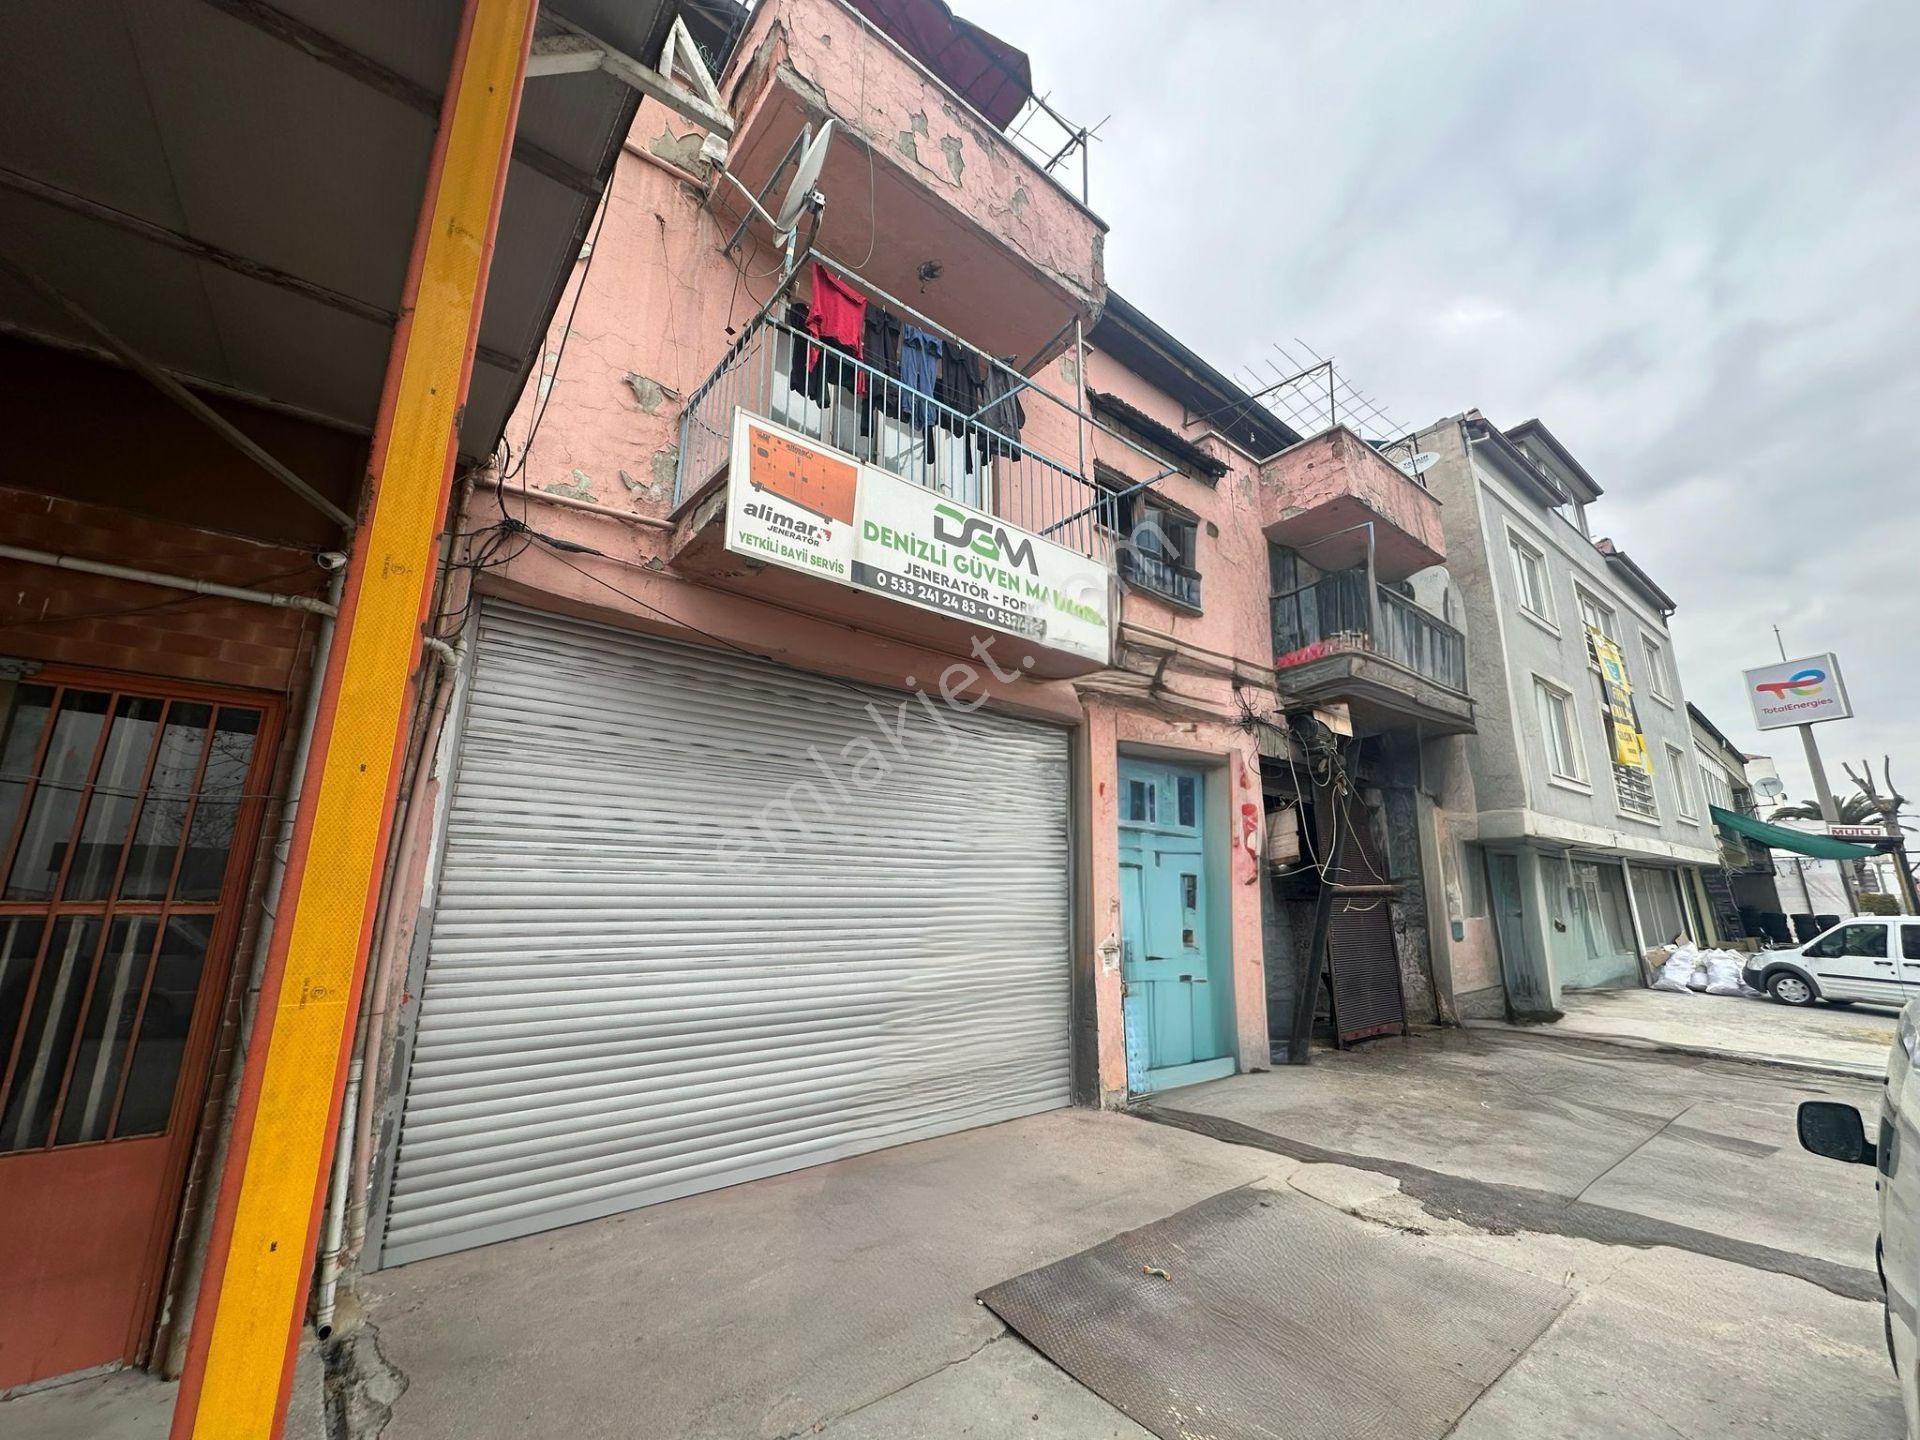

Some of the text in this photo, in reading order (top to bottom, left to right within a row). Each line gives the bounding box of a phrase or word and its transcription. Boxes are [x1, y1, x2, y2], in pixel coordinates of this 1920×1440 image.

[744, 503, 818, 537] alimar
[767, 525, 820, 547] JENERATÖR
[739, 531, 779, 554] YETKİLİ
[810, 558, 844, 574] SERVİS
[863, 519, 1019, 593] DENİZLİ GÜVEN
[876, 572, 886, 587] 0
[890, 577, 914, 596] 533
[918, 585, 939, 604] 241
[942, 594, 958, 609] 24
[961, 600, 976, 615] 83
[986, 608, 995, 620] 0
[903, 562, 989, 601] JENERATÖR
[1761, 697, 1834, 715] TotalEnergies
